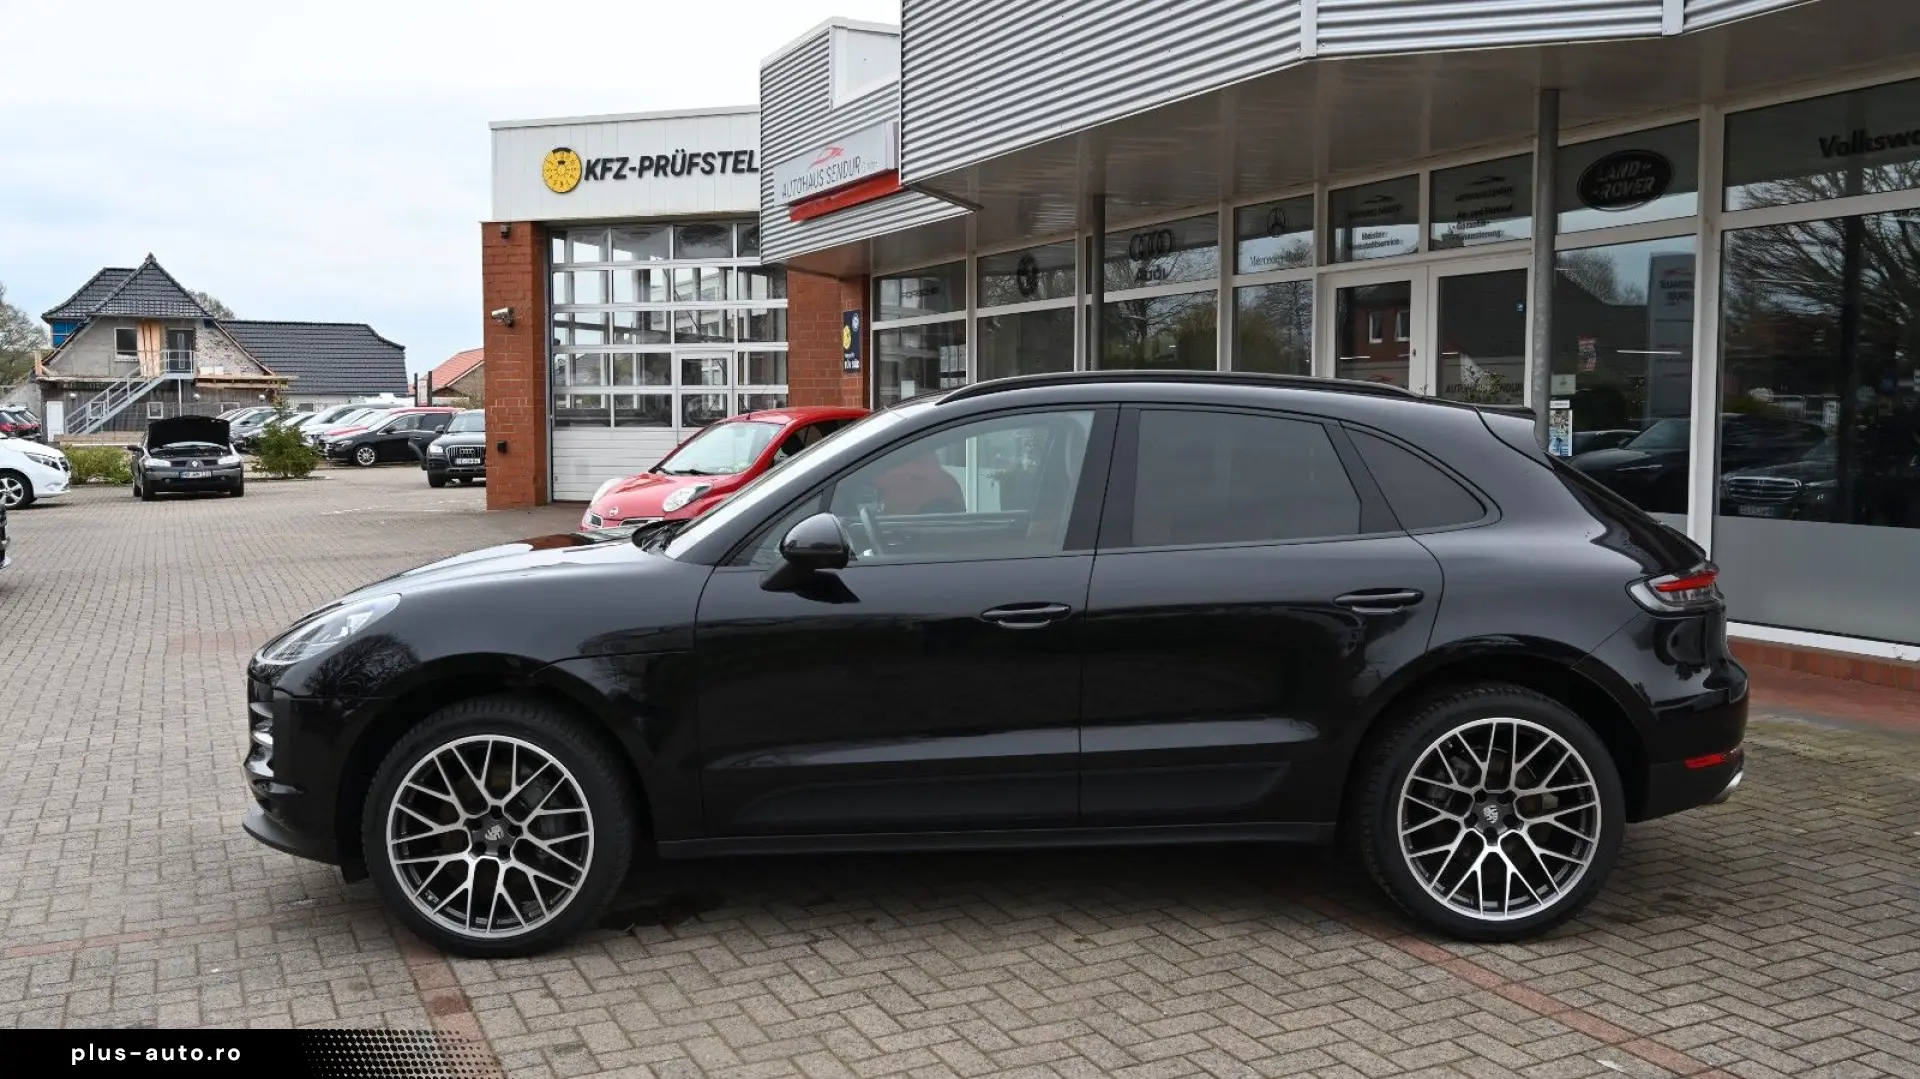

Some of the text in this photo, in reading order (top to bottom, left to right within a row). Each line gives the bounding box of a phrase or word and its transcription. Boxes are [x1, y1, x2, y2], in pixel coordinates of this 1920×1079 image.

[584, 148, 759, 181] KFZ-PRÜFSTEL
[782, 168, 824, 198] AUTOHAUS
[826, 156, 860, 185] SENDUR
